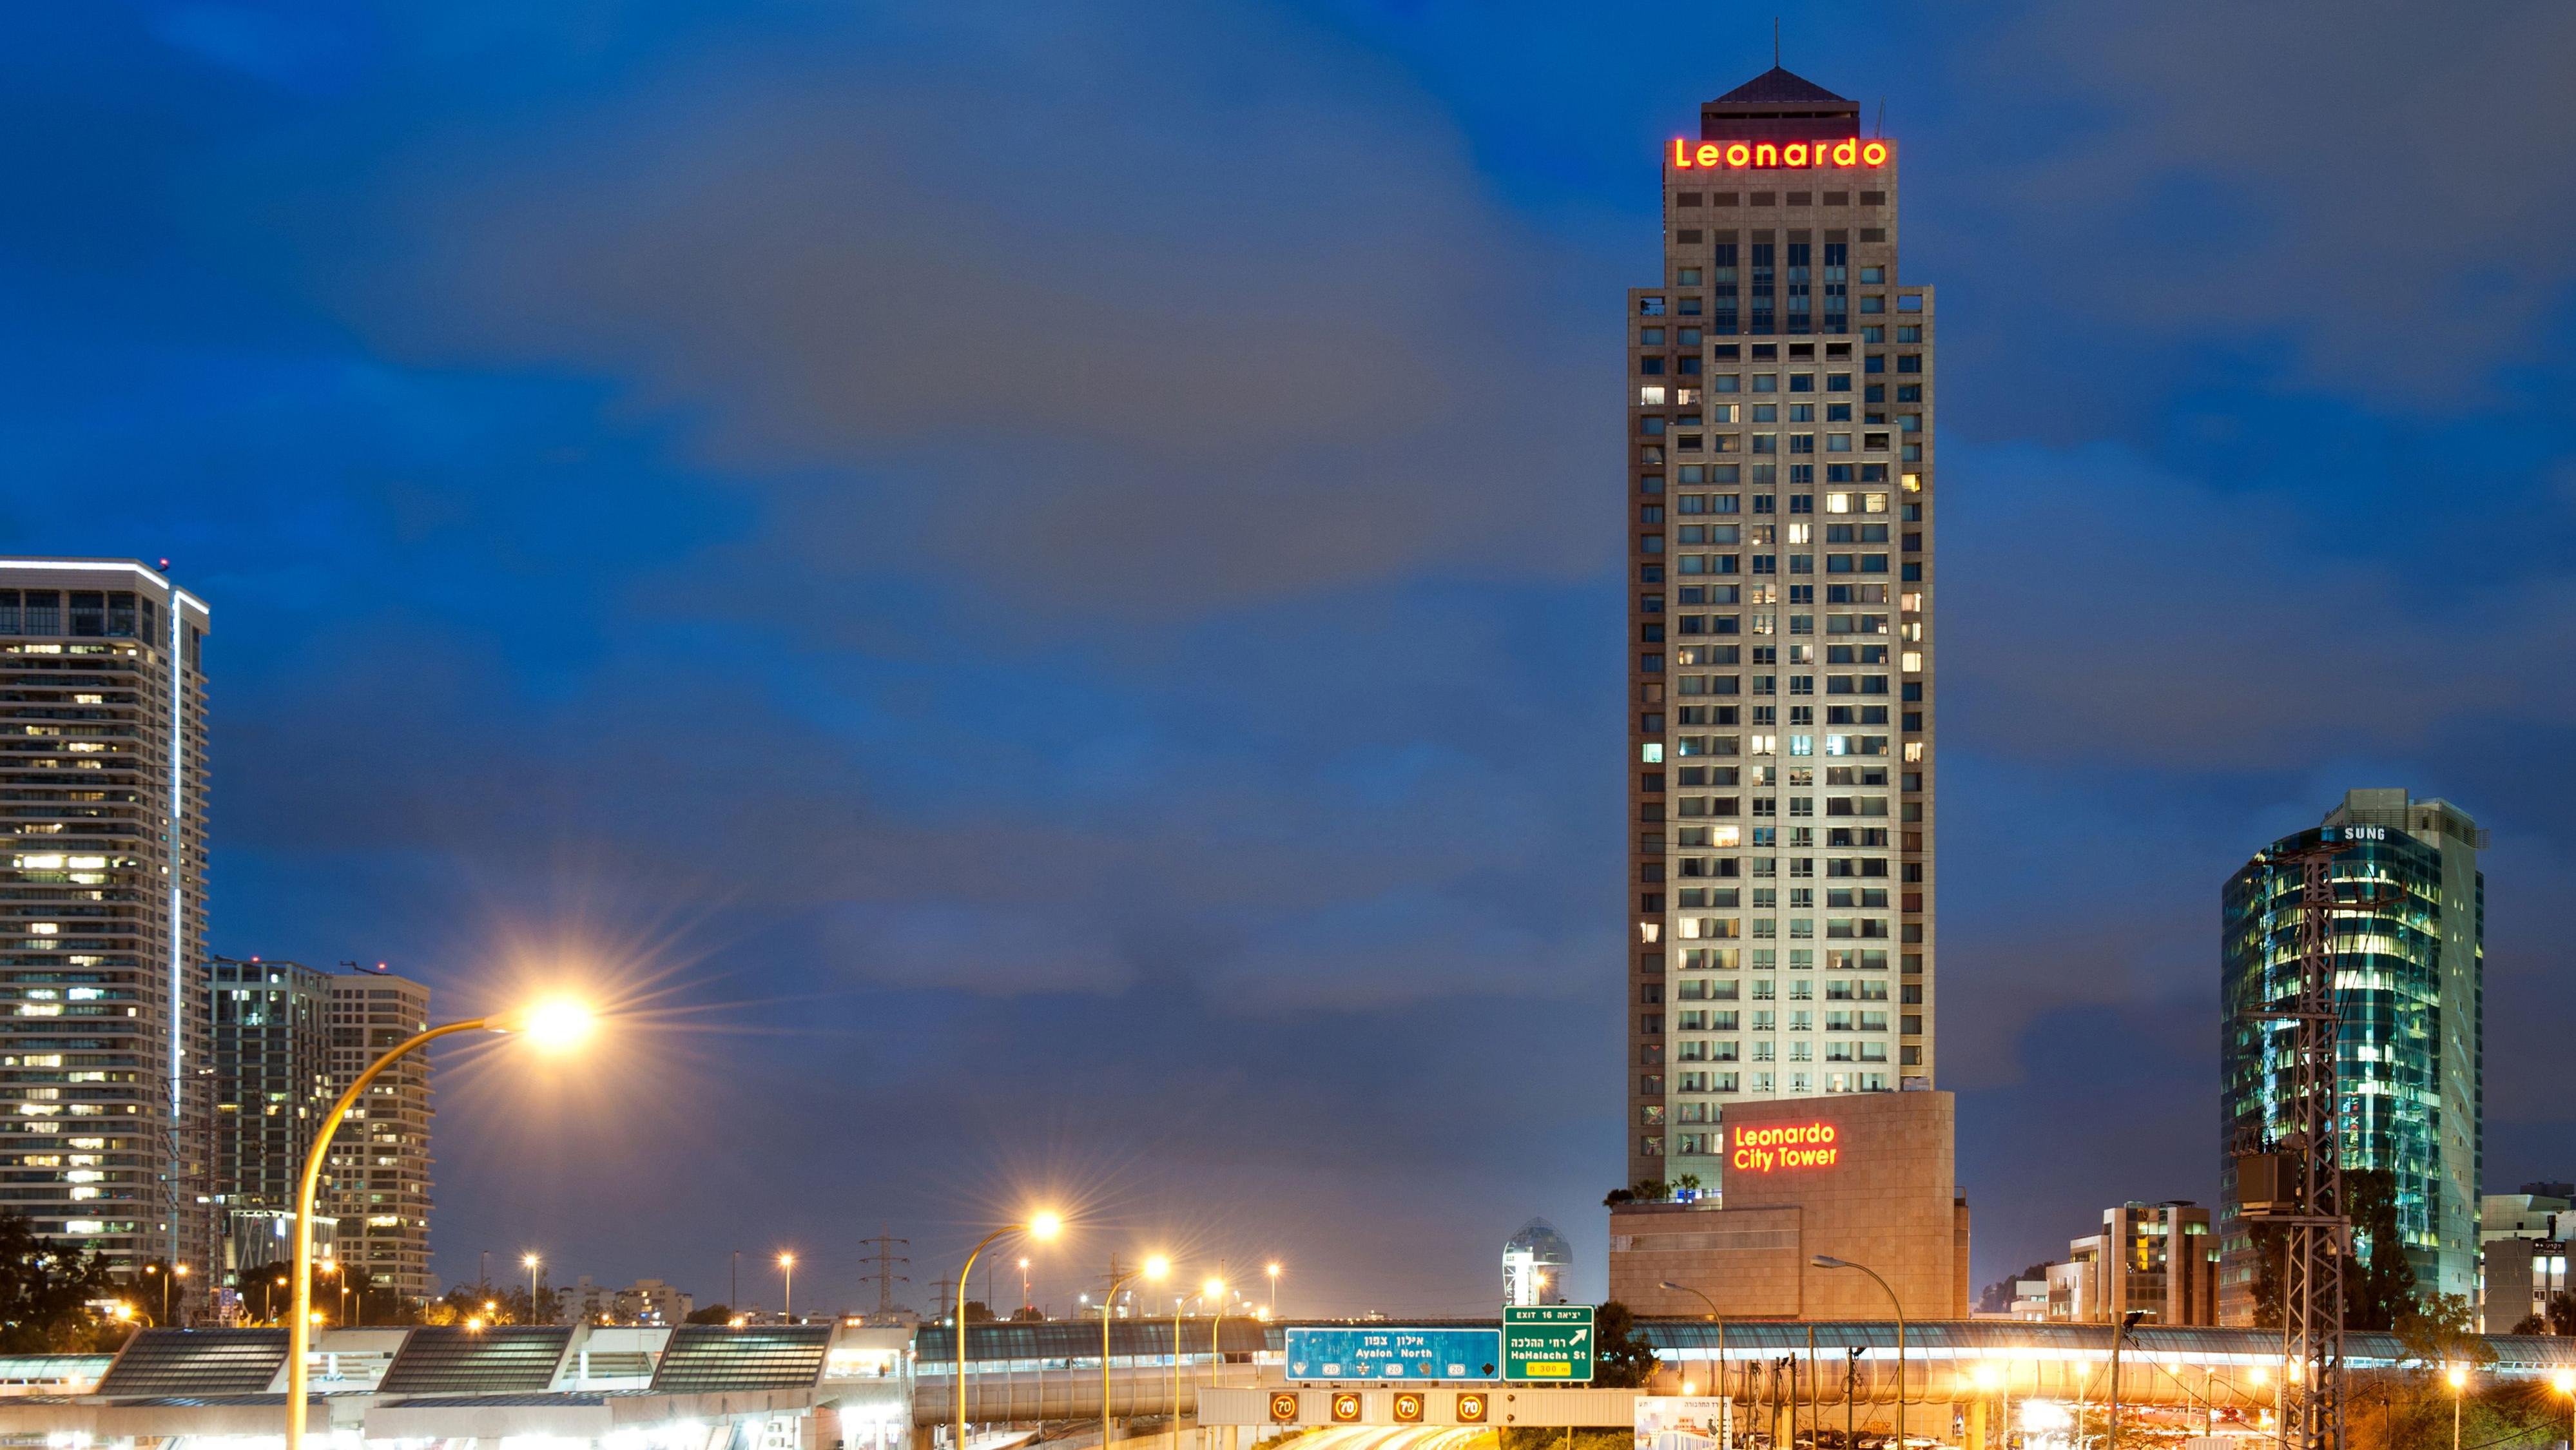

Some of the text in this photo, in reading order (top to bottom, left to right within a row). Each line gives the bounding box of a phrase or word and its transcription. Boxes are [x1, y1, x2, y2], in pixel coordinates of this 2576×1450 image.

[1676, 137, 1887, 167] Leonardo
[2345, 827, 2385, 840] SUNG
[1736, 1122, 1835, 1146] Leonardo
[1734, 1146, 1837, 1172] City Tower
[1364, 1335, 1424, 1346] אילון צפון
[1511, 1337, 1544, 1348] ההלכה
[1355, 1348, 1433, 1359] Ayalon North
[1511, 1350, 1586, 1360] HaHalacha St
[1277, 1401, 1291, 1412] 70
[1341, 1400, 1354, 1413] 70
[1400, 1400, 1415, 1413] 70
[1464, 1400, 1478, 1413] 70
